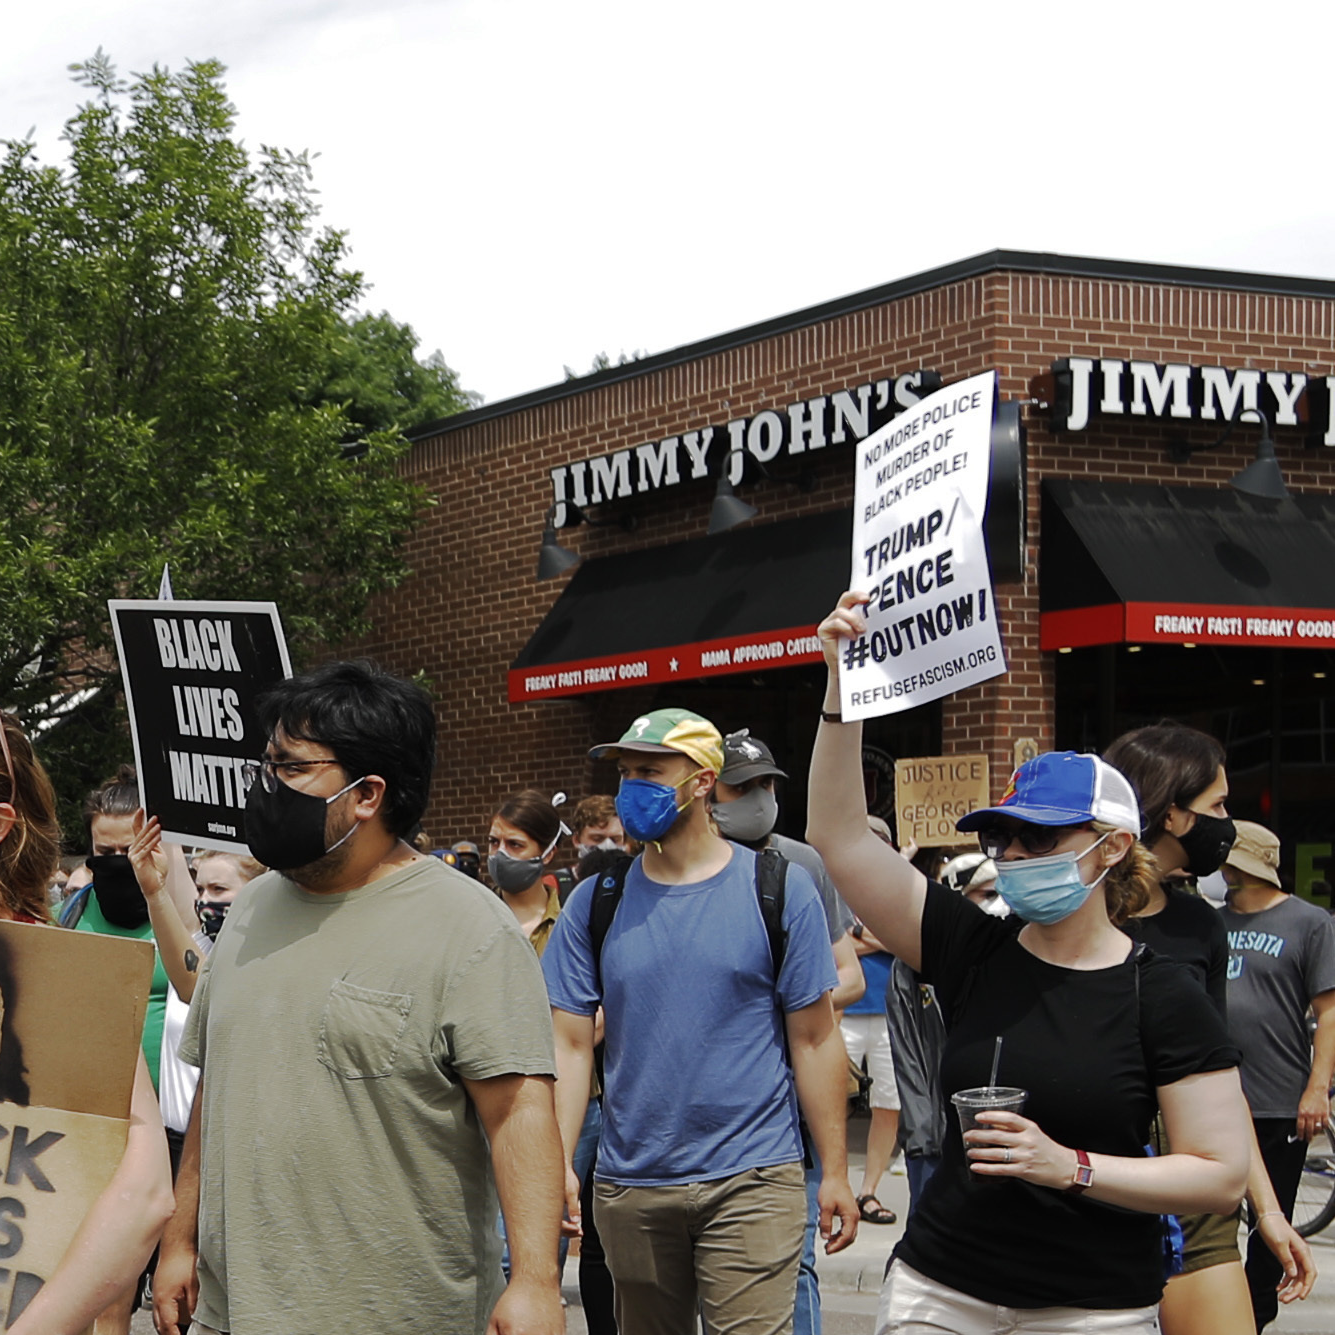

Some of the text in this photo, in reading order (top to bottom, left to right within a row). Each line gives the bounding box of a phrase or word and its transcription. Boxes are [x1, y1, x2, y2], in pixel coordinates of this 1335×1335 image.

[1067, 358, 1307, 431] JIMMY
[551, 370, 922, 528] JIMMY JOHN'S
[864, 391, 982, 470] NO MORE POLICE
[876, 428, 954, 488] MURDER OF
[864, 452, 968, 524] BLACK PEOPLE!
[863, 549, 954, 618] PENCE
[153, 618, 242, 672] BLACK
[701, 649, 731, 668] MAMA
[733, 640, 785, 663] APPROVED
[843, 588, 987, 671] #OUTNOW!
[1154, 614, 1335, 639] FREAKY FAST! FREAKY GOOD!
[525, 661, 648, 692] FREAKY FAST! FREAKY GOOD!
[851, 645, 997, 706] REFUSEFASCISM.ORG
[173, 685, 245, 742] LIVES
[169, 750, 262, 810] MATTE
[902, 762, 981, 784] JUSTICE
[902, 799, 980, 822] GEORGE
[913, 820, 974, 838] FLOY
[1227, 930, 1285, 958] NESOTA
